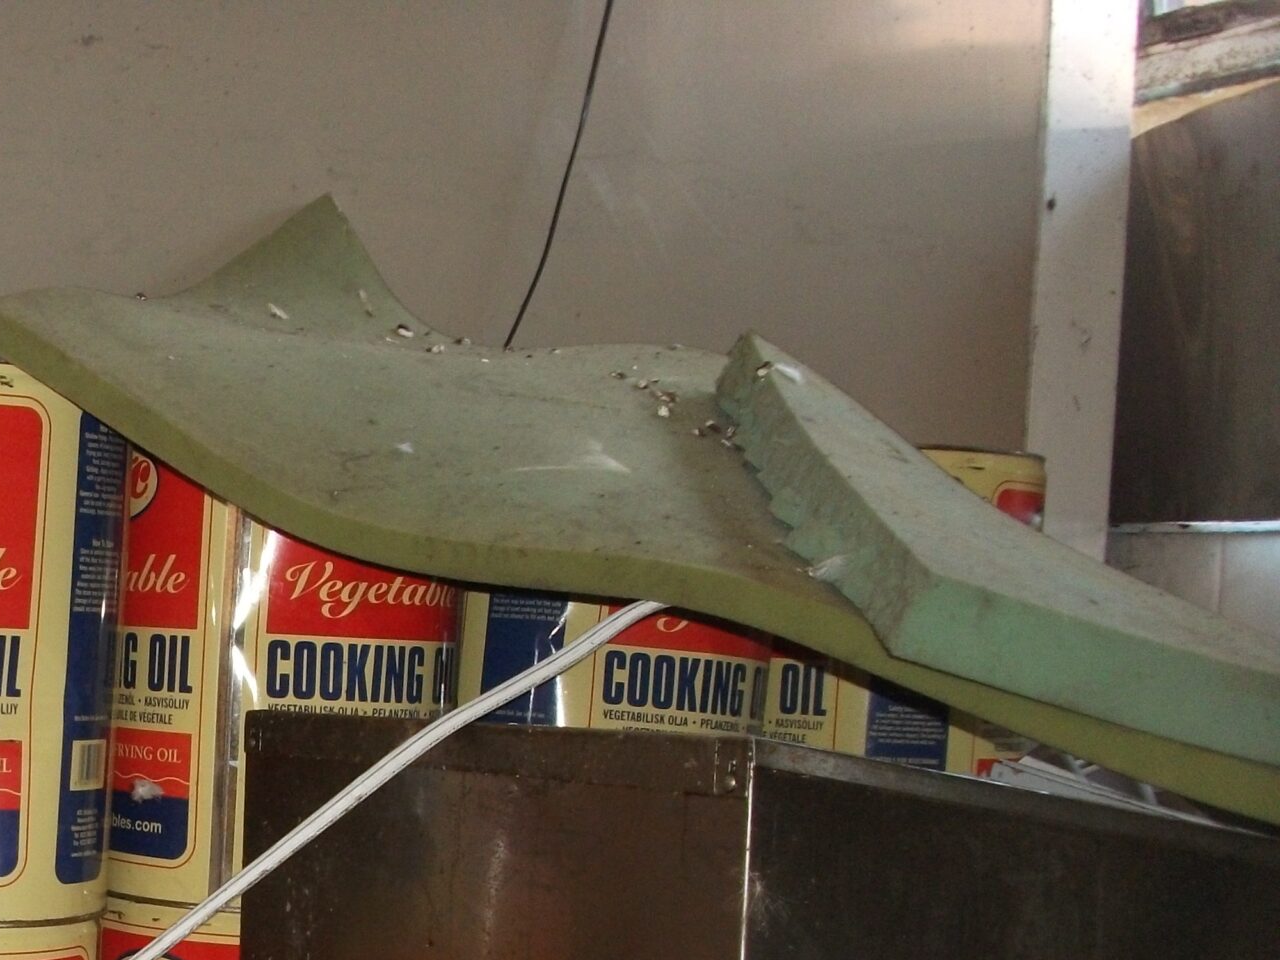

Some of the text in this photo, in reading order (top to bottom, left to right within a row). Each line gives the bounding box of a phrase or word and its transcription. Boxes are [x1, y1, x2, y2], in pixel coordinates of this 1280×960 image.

[148, 633, 193, 694] OIL
[266, 639, 425, 705] COOKING
[602, 650, 747, 718] COOKING
[779, 663, 827, 717] OIL
[603, 709, 666, 726] VEGETABILISK
[668, 714, 688, 727] OLJA
[116, 743, 182, 763] RYING OIL
